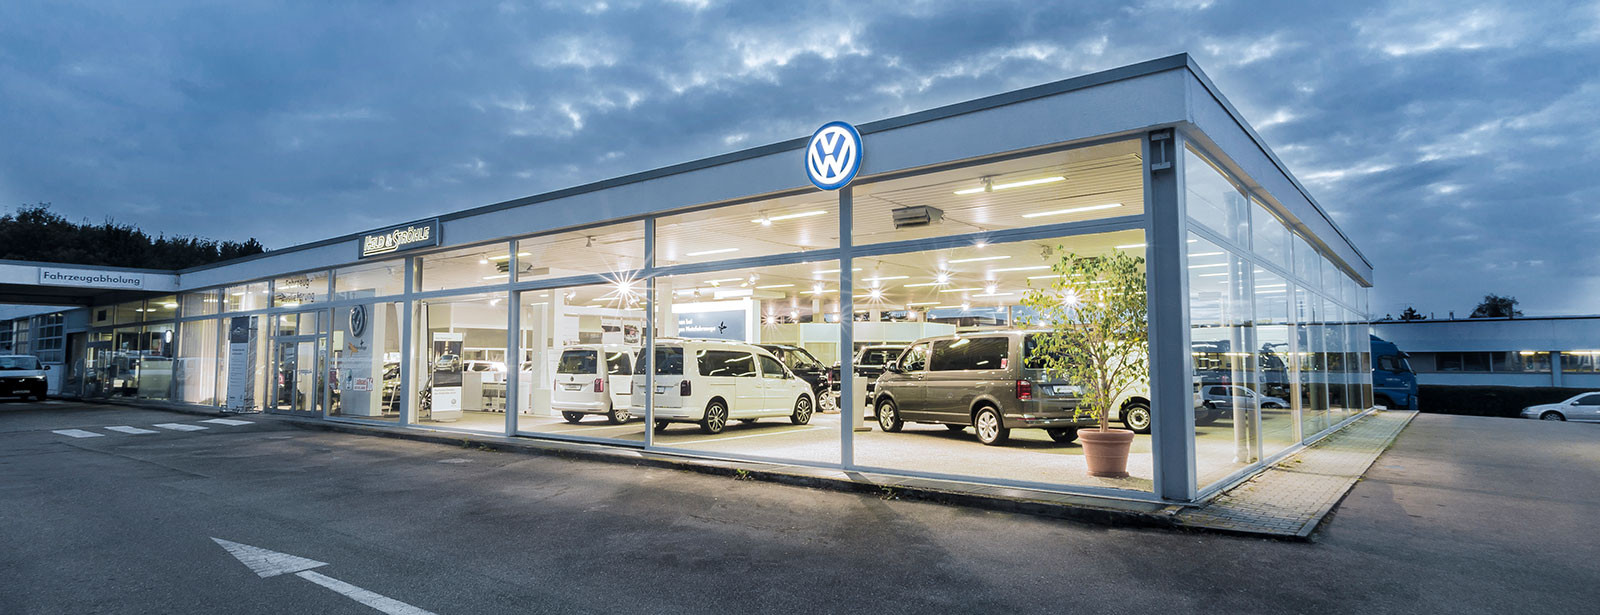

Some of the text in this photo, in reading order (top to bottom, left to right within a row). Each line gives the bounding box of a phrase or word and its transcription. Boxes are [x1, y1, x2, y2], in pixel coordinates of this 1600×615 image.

[808, 126, 857, 185] VW
[364, 235, 385, 251] HELD
[385, 233, 393, 247] &
[43, 271, 140, 286] Fahrzeugabholung
